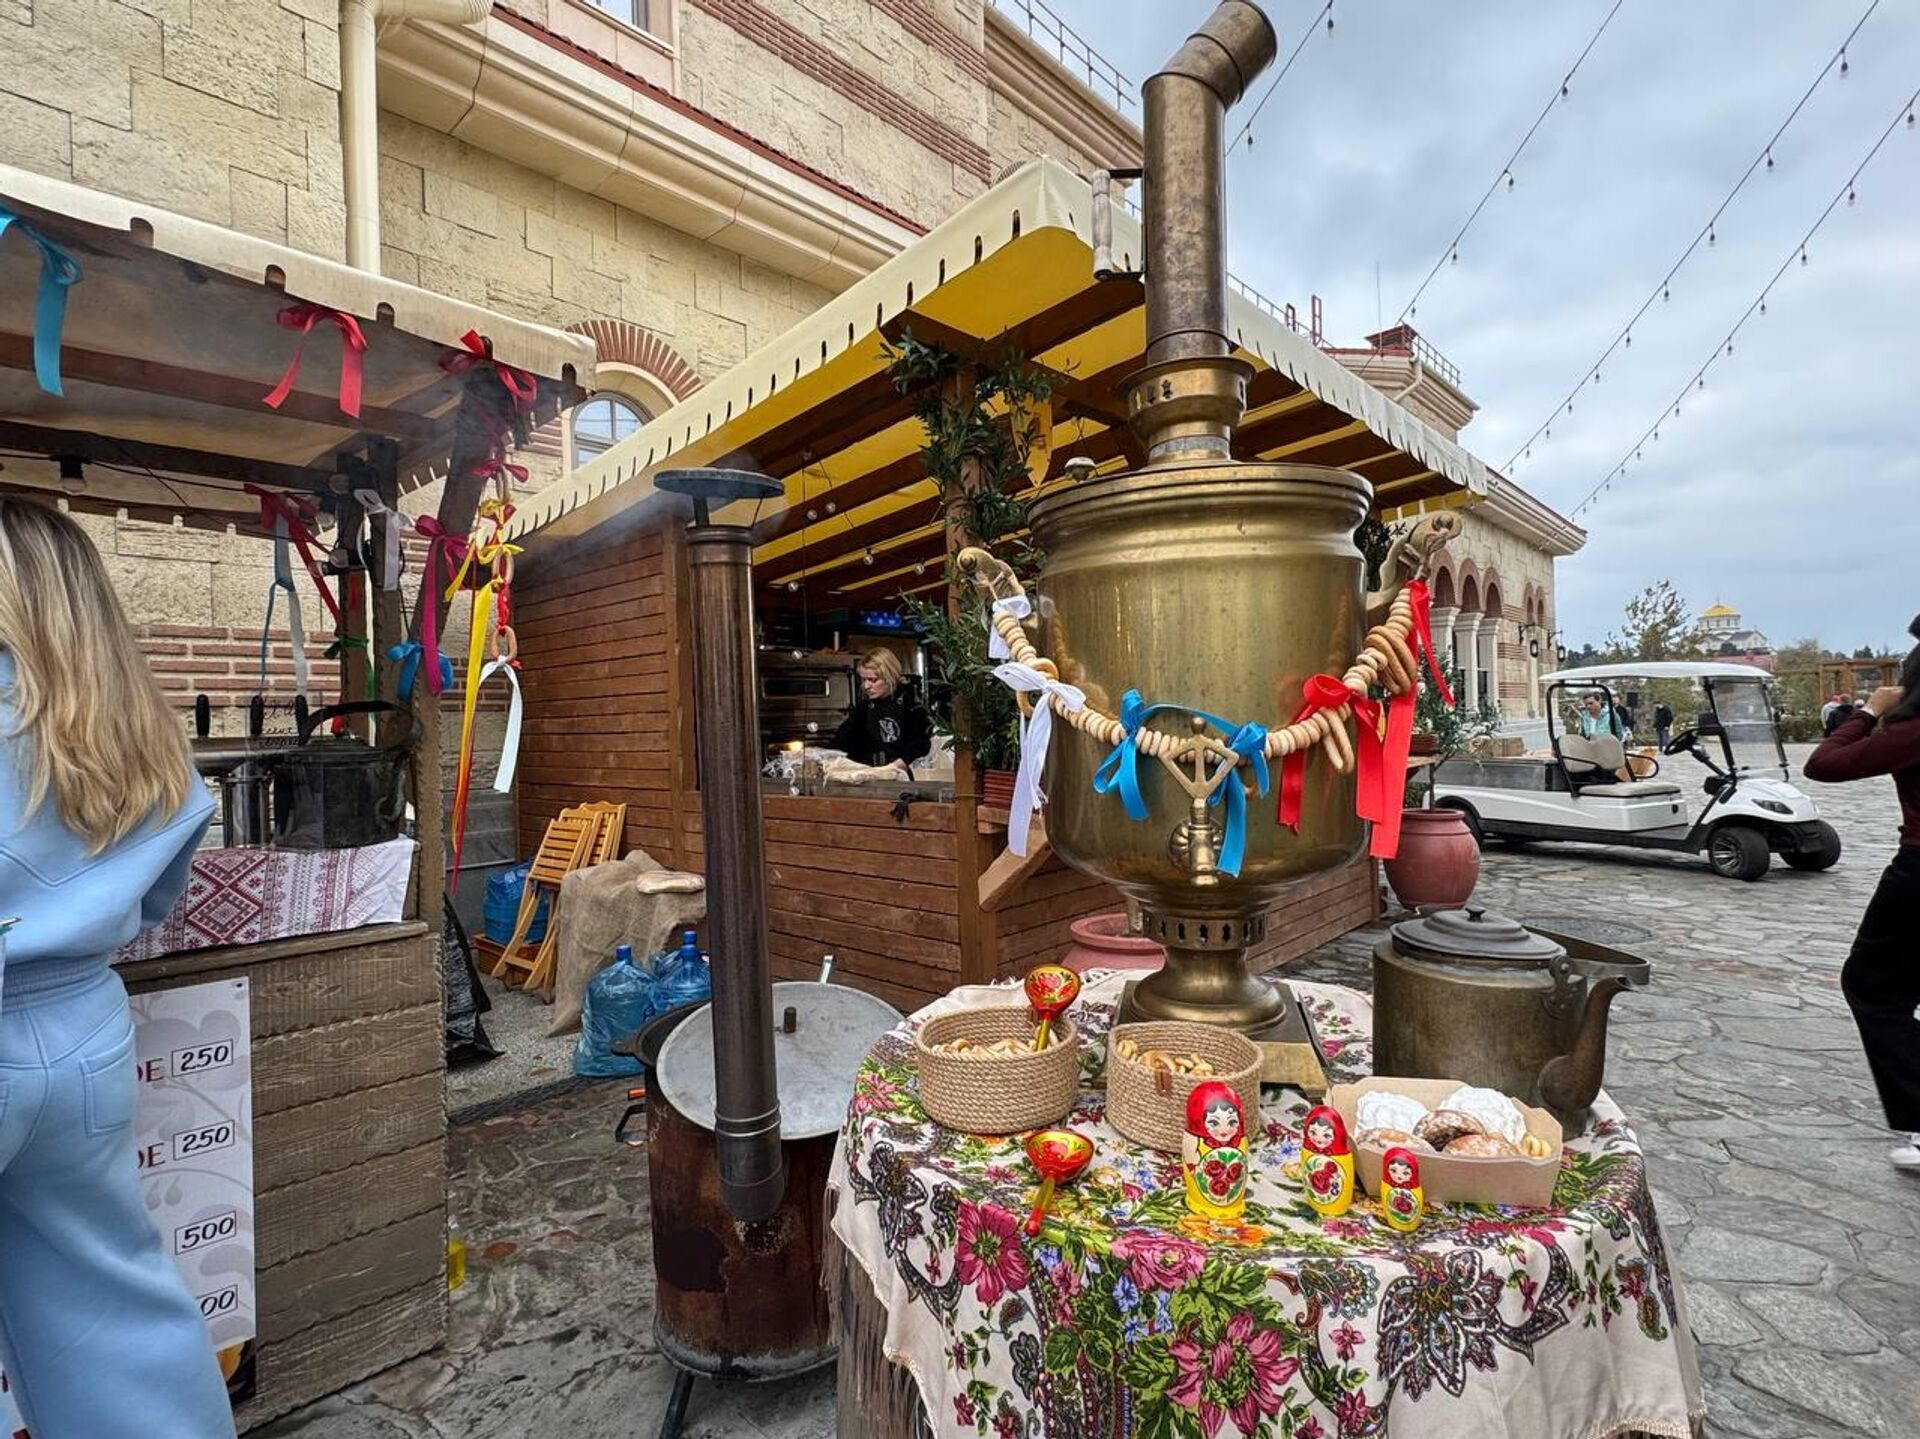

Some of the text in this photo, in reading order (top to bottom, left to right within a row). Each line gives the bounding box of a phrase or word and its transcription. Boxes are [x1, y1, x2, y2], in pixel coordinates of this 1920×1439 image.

[181, 1045, 229, 1071] 250
[182, 1126, 230, 1152] 250
[182, 1217, 234, 1249] 500
[200, 1290, 235, 1316] 00
